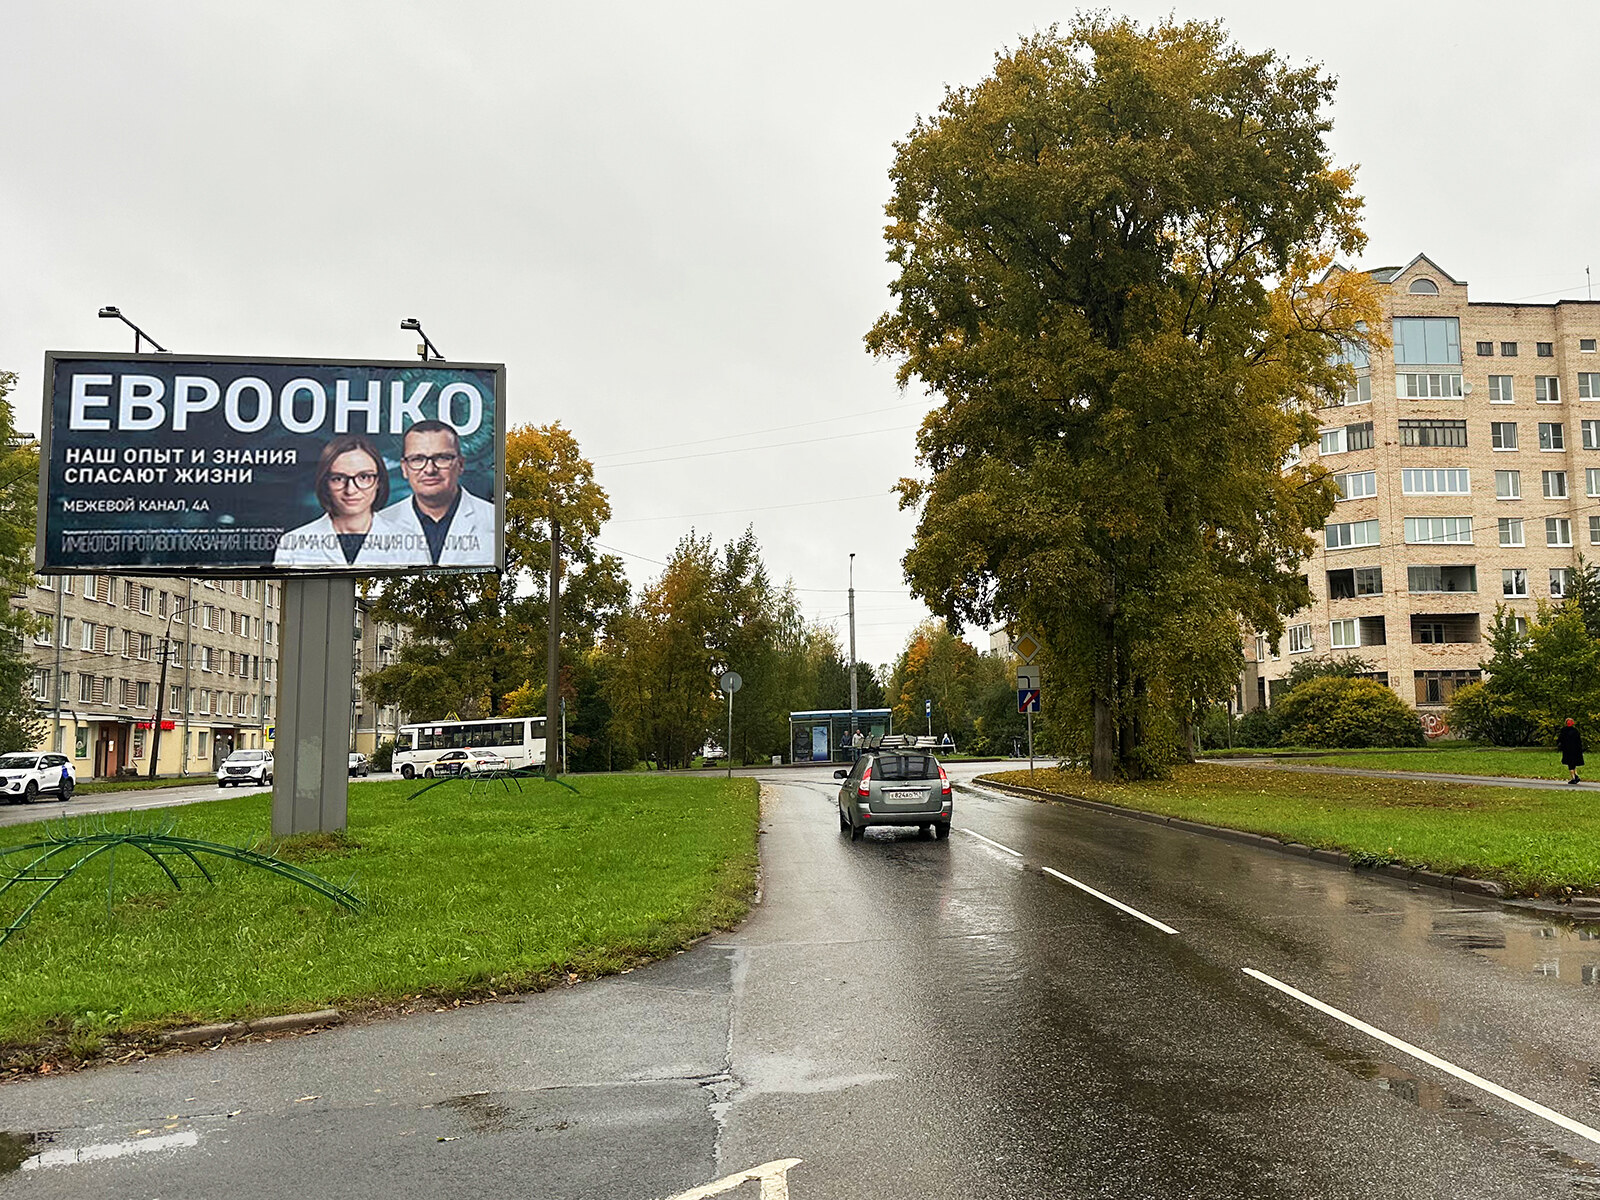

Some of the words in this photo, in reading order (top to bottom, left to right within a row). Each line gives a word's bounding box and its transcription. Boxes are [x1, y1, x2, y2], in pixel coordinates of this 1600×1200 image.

[68, 373, 483, 436] ЕВРООНКО
[65, 448, 116, 464] НАШ
[123, 448, 185, 464] ОПЫТ
[191, 449, 206, 464] И
[212, 449, 297, 465] ЗНАНИЯ
[64, 468, 168, 483] СПАСАЮТ
[174, 468, 253, 483] ЖИЗНИ
[63, 497, 135, 512] МЕЖЕВОЙ
[139, 499, 189, 513] КАНАЛ,
[192, 500, 210, 511] 4А
[61, 535, 120, 553] ИМЕЮТСЯ
